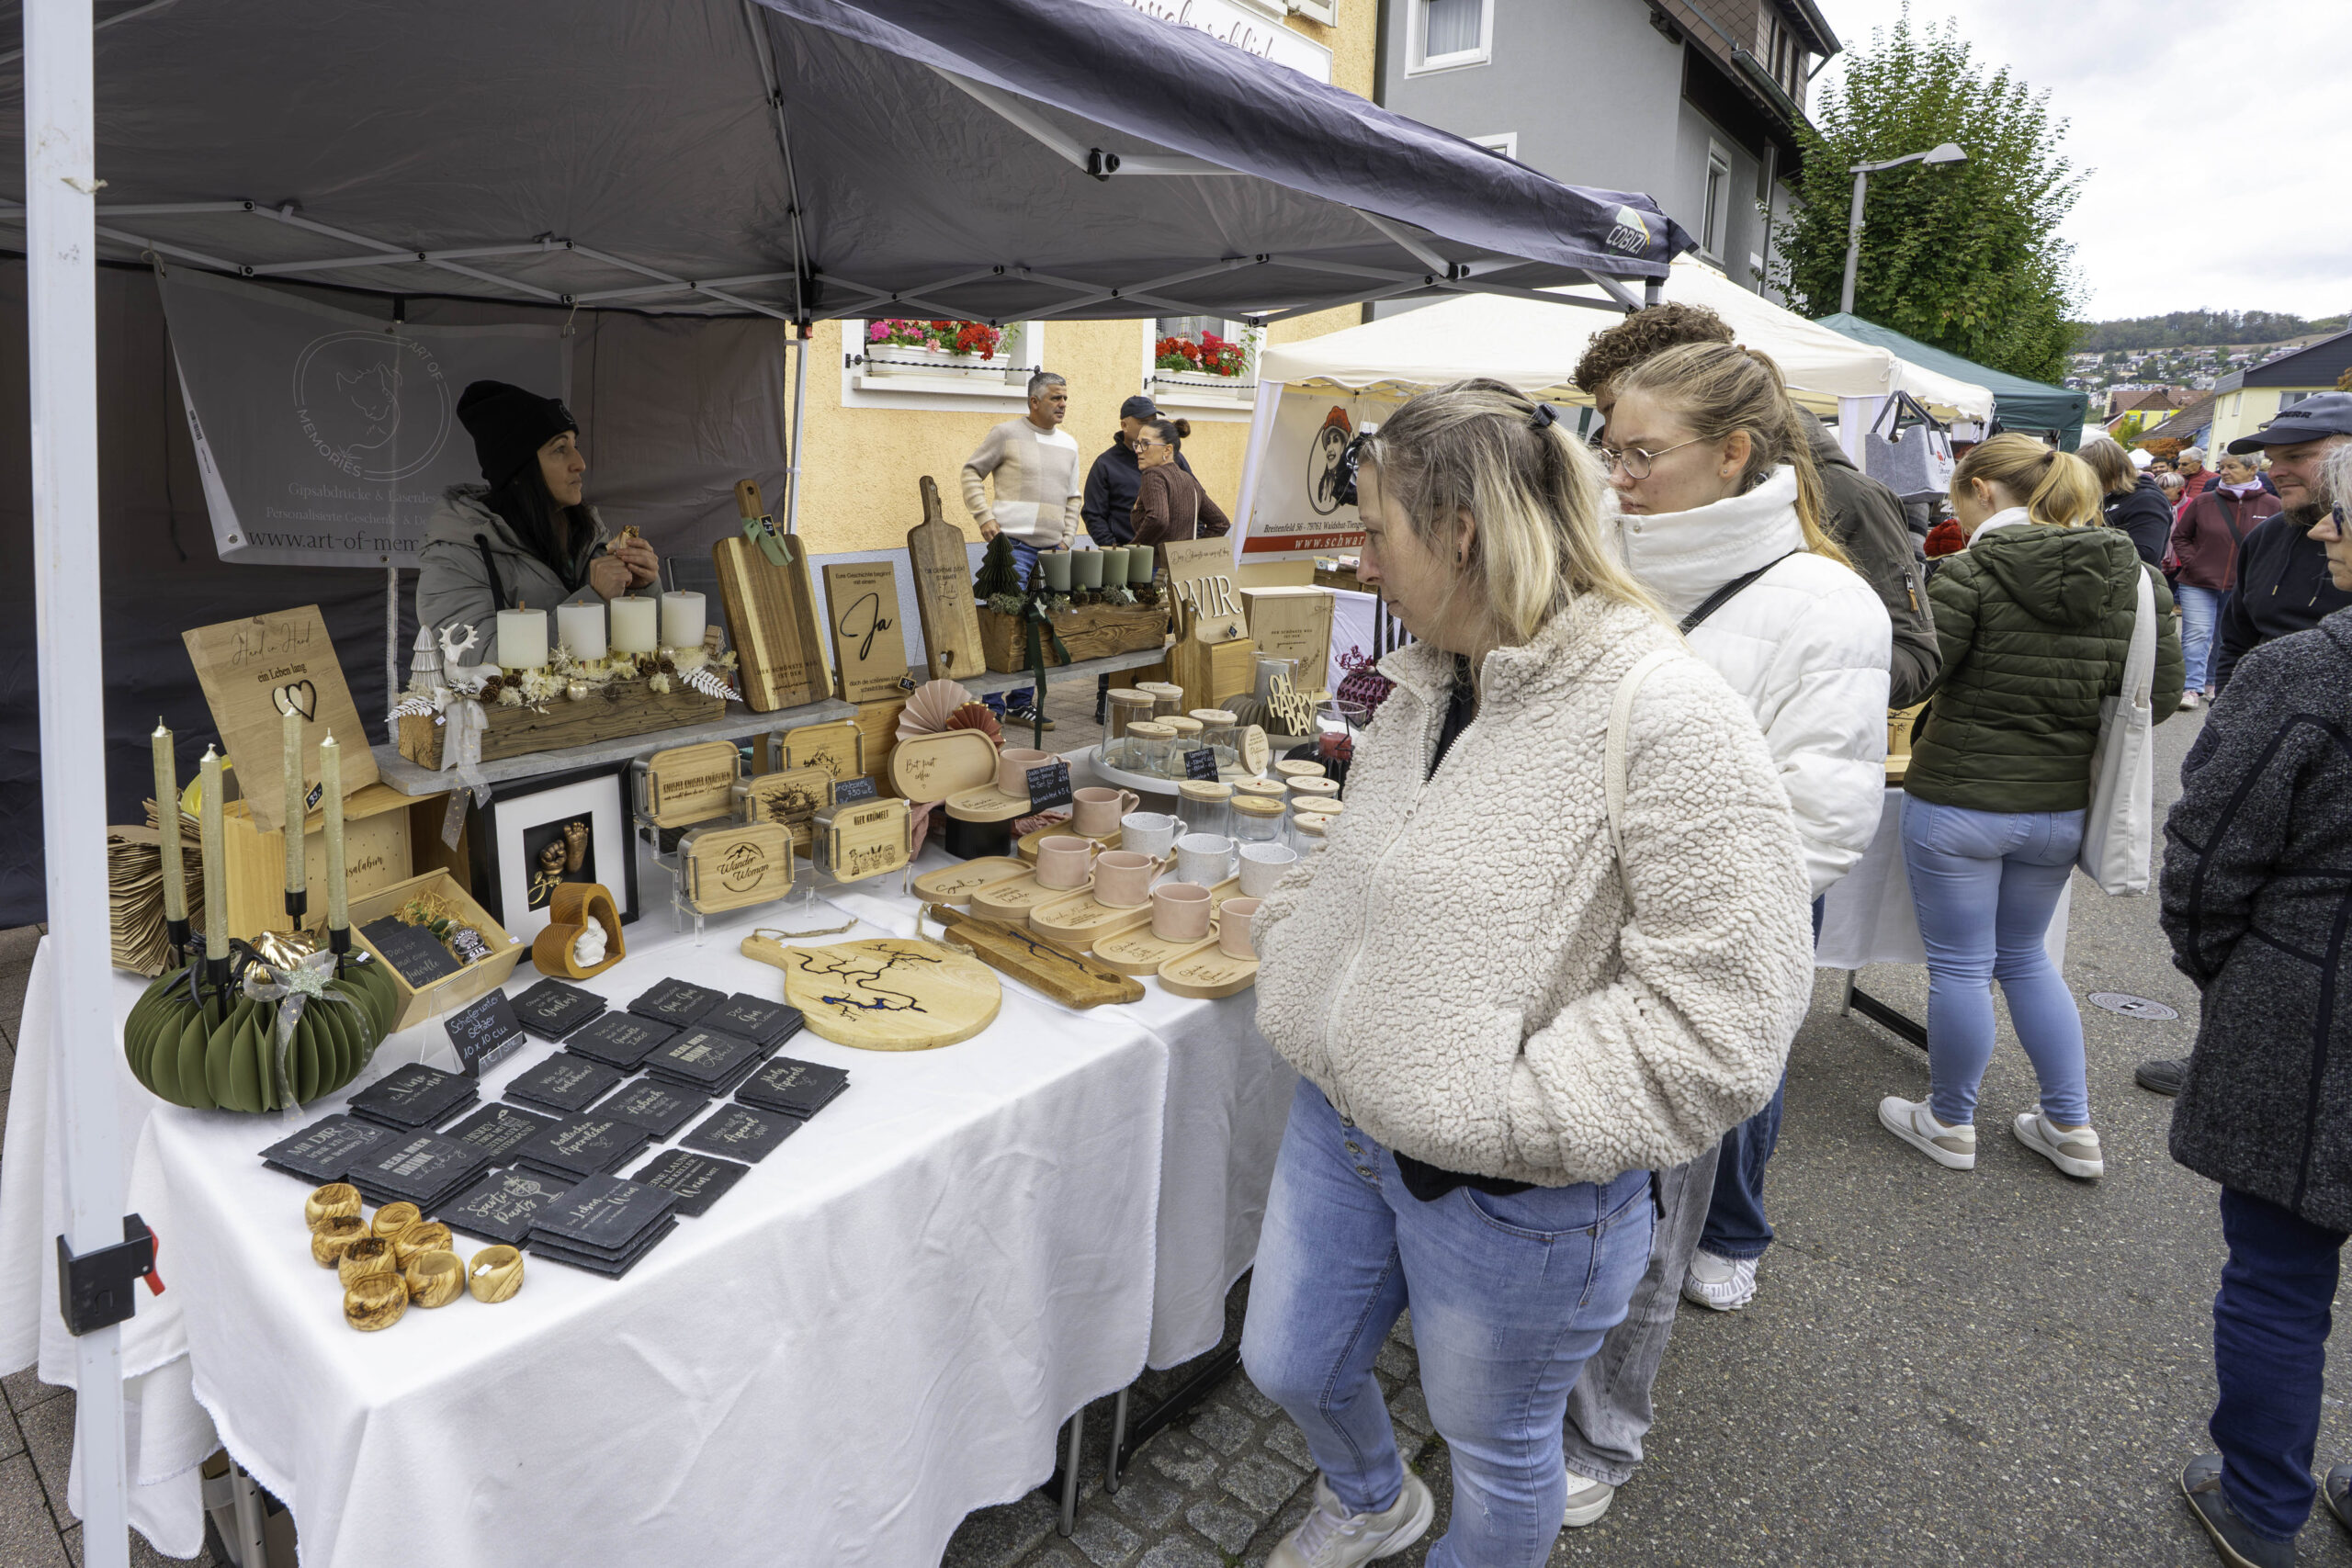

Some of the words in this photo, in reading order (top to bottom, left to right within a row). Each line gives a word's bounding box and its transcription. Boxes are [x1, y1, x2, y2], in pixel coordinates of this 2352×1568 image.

[1606, 224, 1647, 254] COBIZI
[407, 341, 434, 362] ART
[426, 361, 445, 381] OF
[297, 409, 362, 479] MEMORIES
[288, 482, 372, 502] Gipsabdrücke
[375, 491, 383, 501] &
[266, 506, 343, 523] Personalisierte
[345, 512, 400, 525] Geschenk
[403, 514, 412, 525] &
[1264, 522, 1295, 533] Breitenfeld
[1306, 522, 1322, 531] 79761
[1295, 533, 1365, 549] www.schwar
[840, 592, 893, 661] Ja
[280, 621, 311, 654] Hand
[257, 670, 270, 683] ein
[270, 667, 292, 681] Leben
[292, 661, 307, 674] lang
[1270, 671, 1294, 696] OH
[1267, 691, 1314, 718] HAPPY
[906, 759, 921, 773] But
[922, 757, 937, 770] first
[663, 781, 684, 794] KNUSPER
[684, 776, 704, 788] KNUSPER
[915, 770, 930, 781] coffee
[717, 854, 756, 874] Wander
[733, 863, 770, 881] Woman
[384, 948, 404, 957] Das
[404, 941, 416, 950] ist
[469, 946, 485, 957] GIN
[395, 956, 412, 968] mal
[468, 1014, 495, 1039] setzer
[463, 1045, 474, 1059] 10
[481, 1034, 491, 1045] 10
[669, 1043, 693, 1058] REAL
[687, 1033, 709, 1045] MEN
[680, 1043, 713, 1063] DRINK
[388, 1075, 426, 1093] Vino
[760, 1067, 789, 1083] Holy
[308, 1127, 343, 1145] DIR
[724, 1117, 759, 1143] Aperol
[378, 1152, 410, 1170] REAL
[402, 1137, 433, 1154] MEN
[391, 1152, 435, 1177] DRINK
[647, 1172, 669, 1189] EINE
[663, 1152, 693, 1174] LAUNE
[607, 1185, 639, 1205] Wein
[492, 1200, 537, 1225] Party
[570, 1198, 603, 1219] Leben
